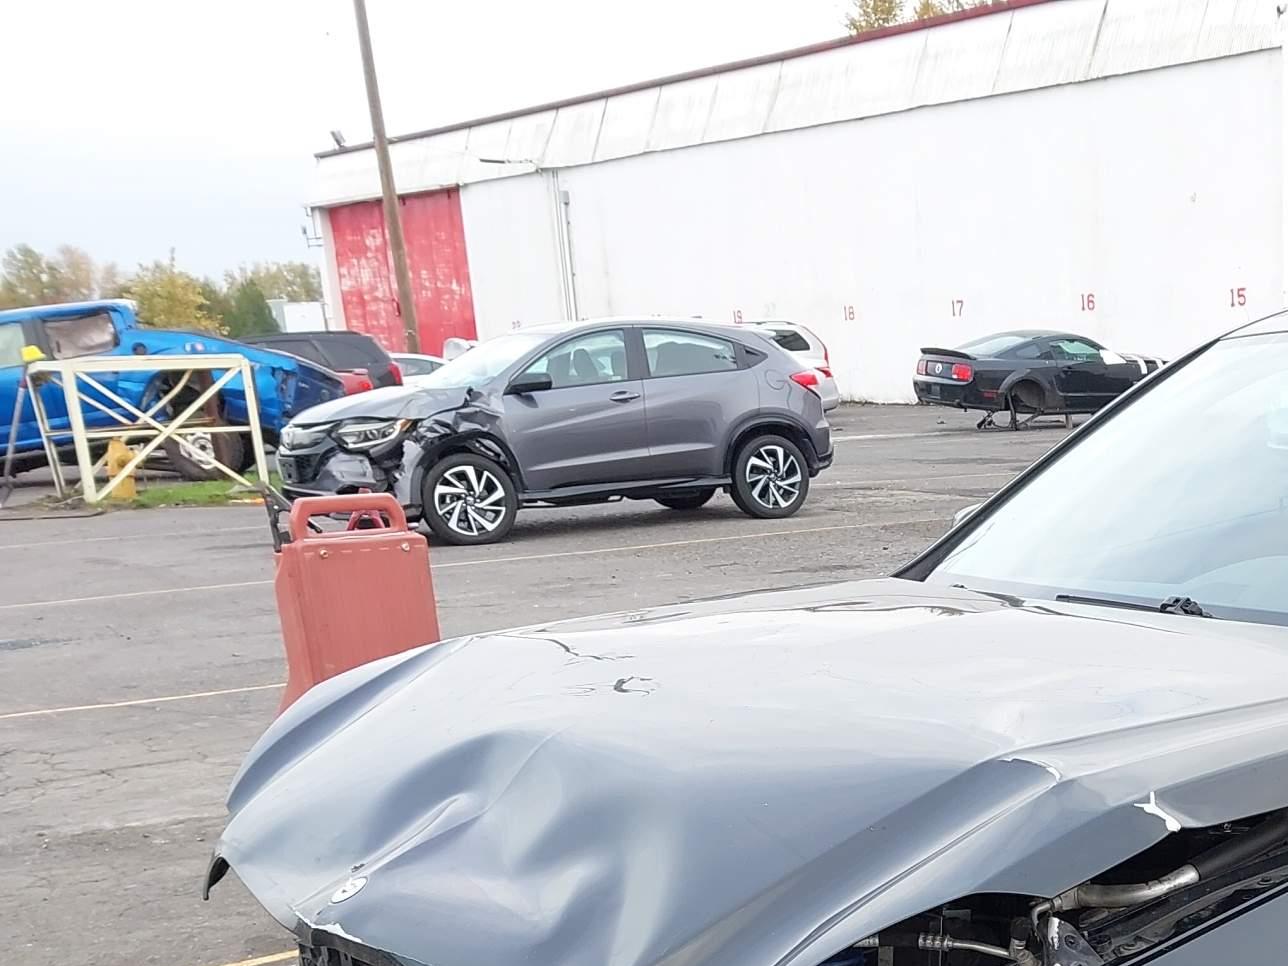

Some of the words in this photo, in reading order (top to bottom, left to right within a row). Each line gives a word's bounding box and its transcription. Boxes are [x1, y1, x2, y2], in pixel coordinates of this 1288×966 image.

[1080, 293, 1096, 311] 16
[1229, 288, 1247, 307] 15
[843, 305, 856, 321] 18
[951, 300, 964, 318] 17
